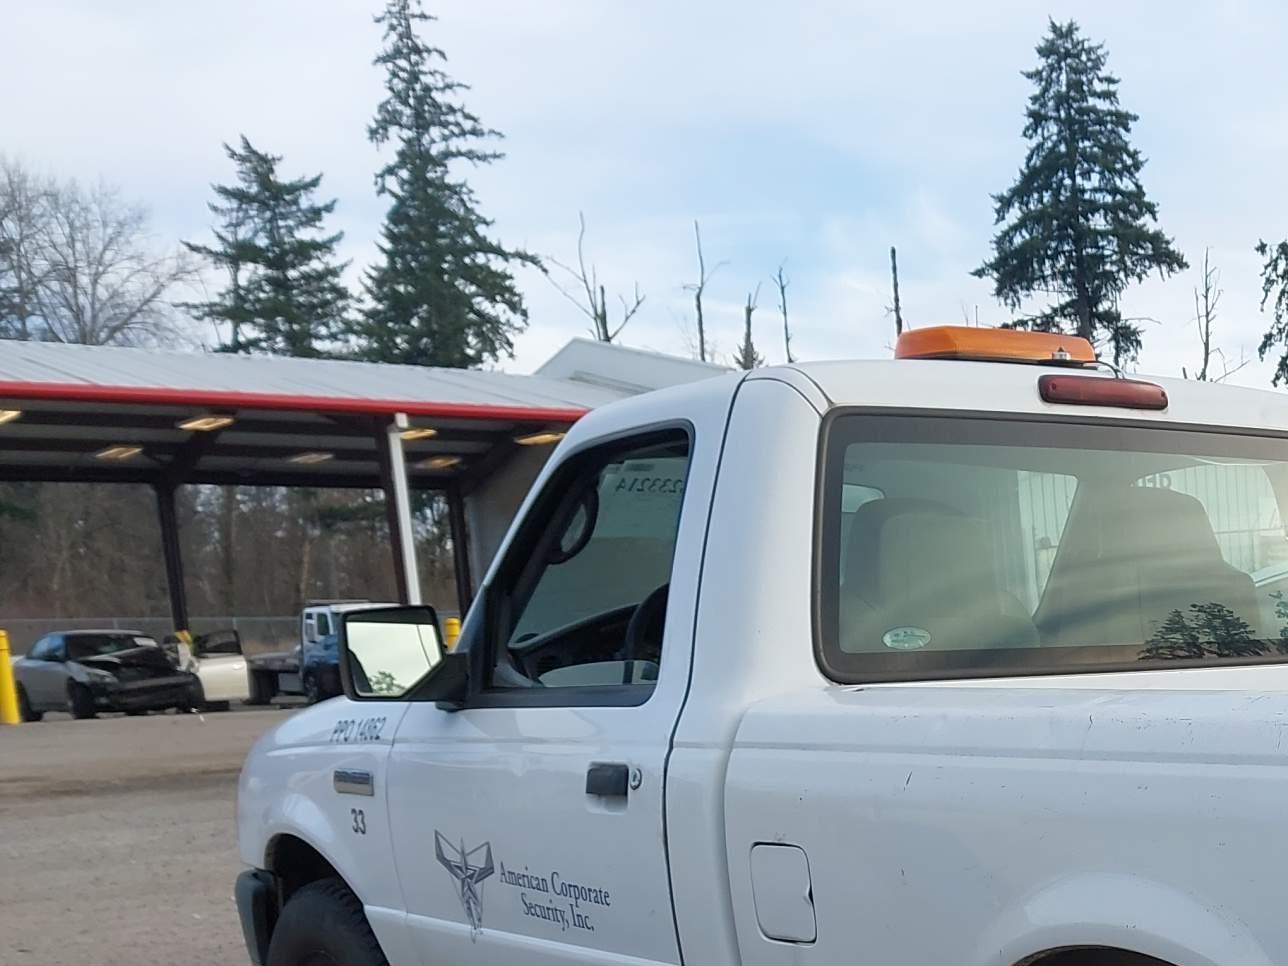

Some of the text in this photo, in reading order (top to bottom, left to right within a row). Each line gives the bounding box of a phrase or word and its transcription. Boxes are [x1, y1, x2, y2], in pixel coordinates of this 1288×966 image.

[328, 719, 356, 743] PPO
[350, 808, 366, 835] 33
[499, 860, 612, 908] American Corporate
[520, 892, 595, 932] Security, Inc.
